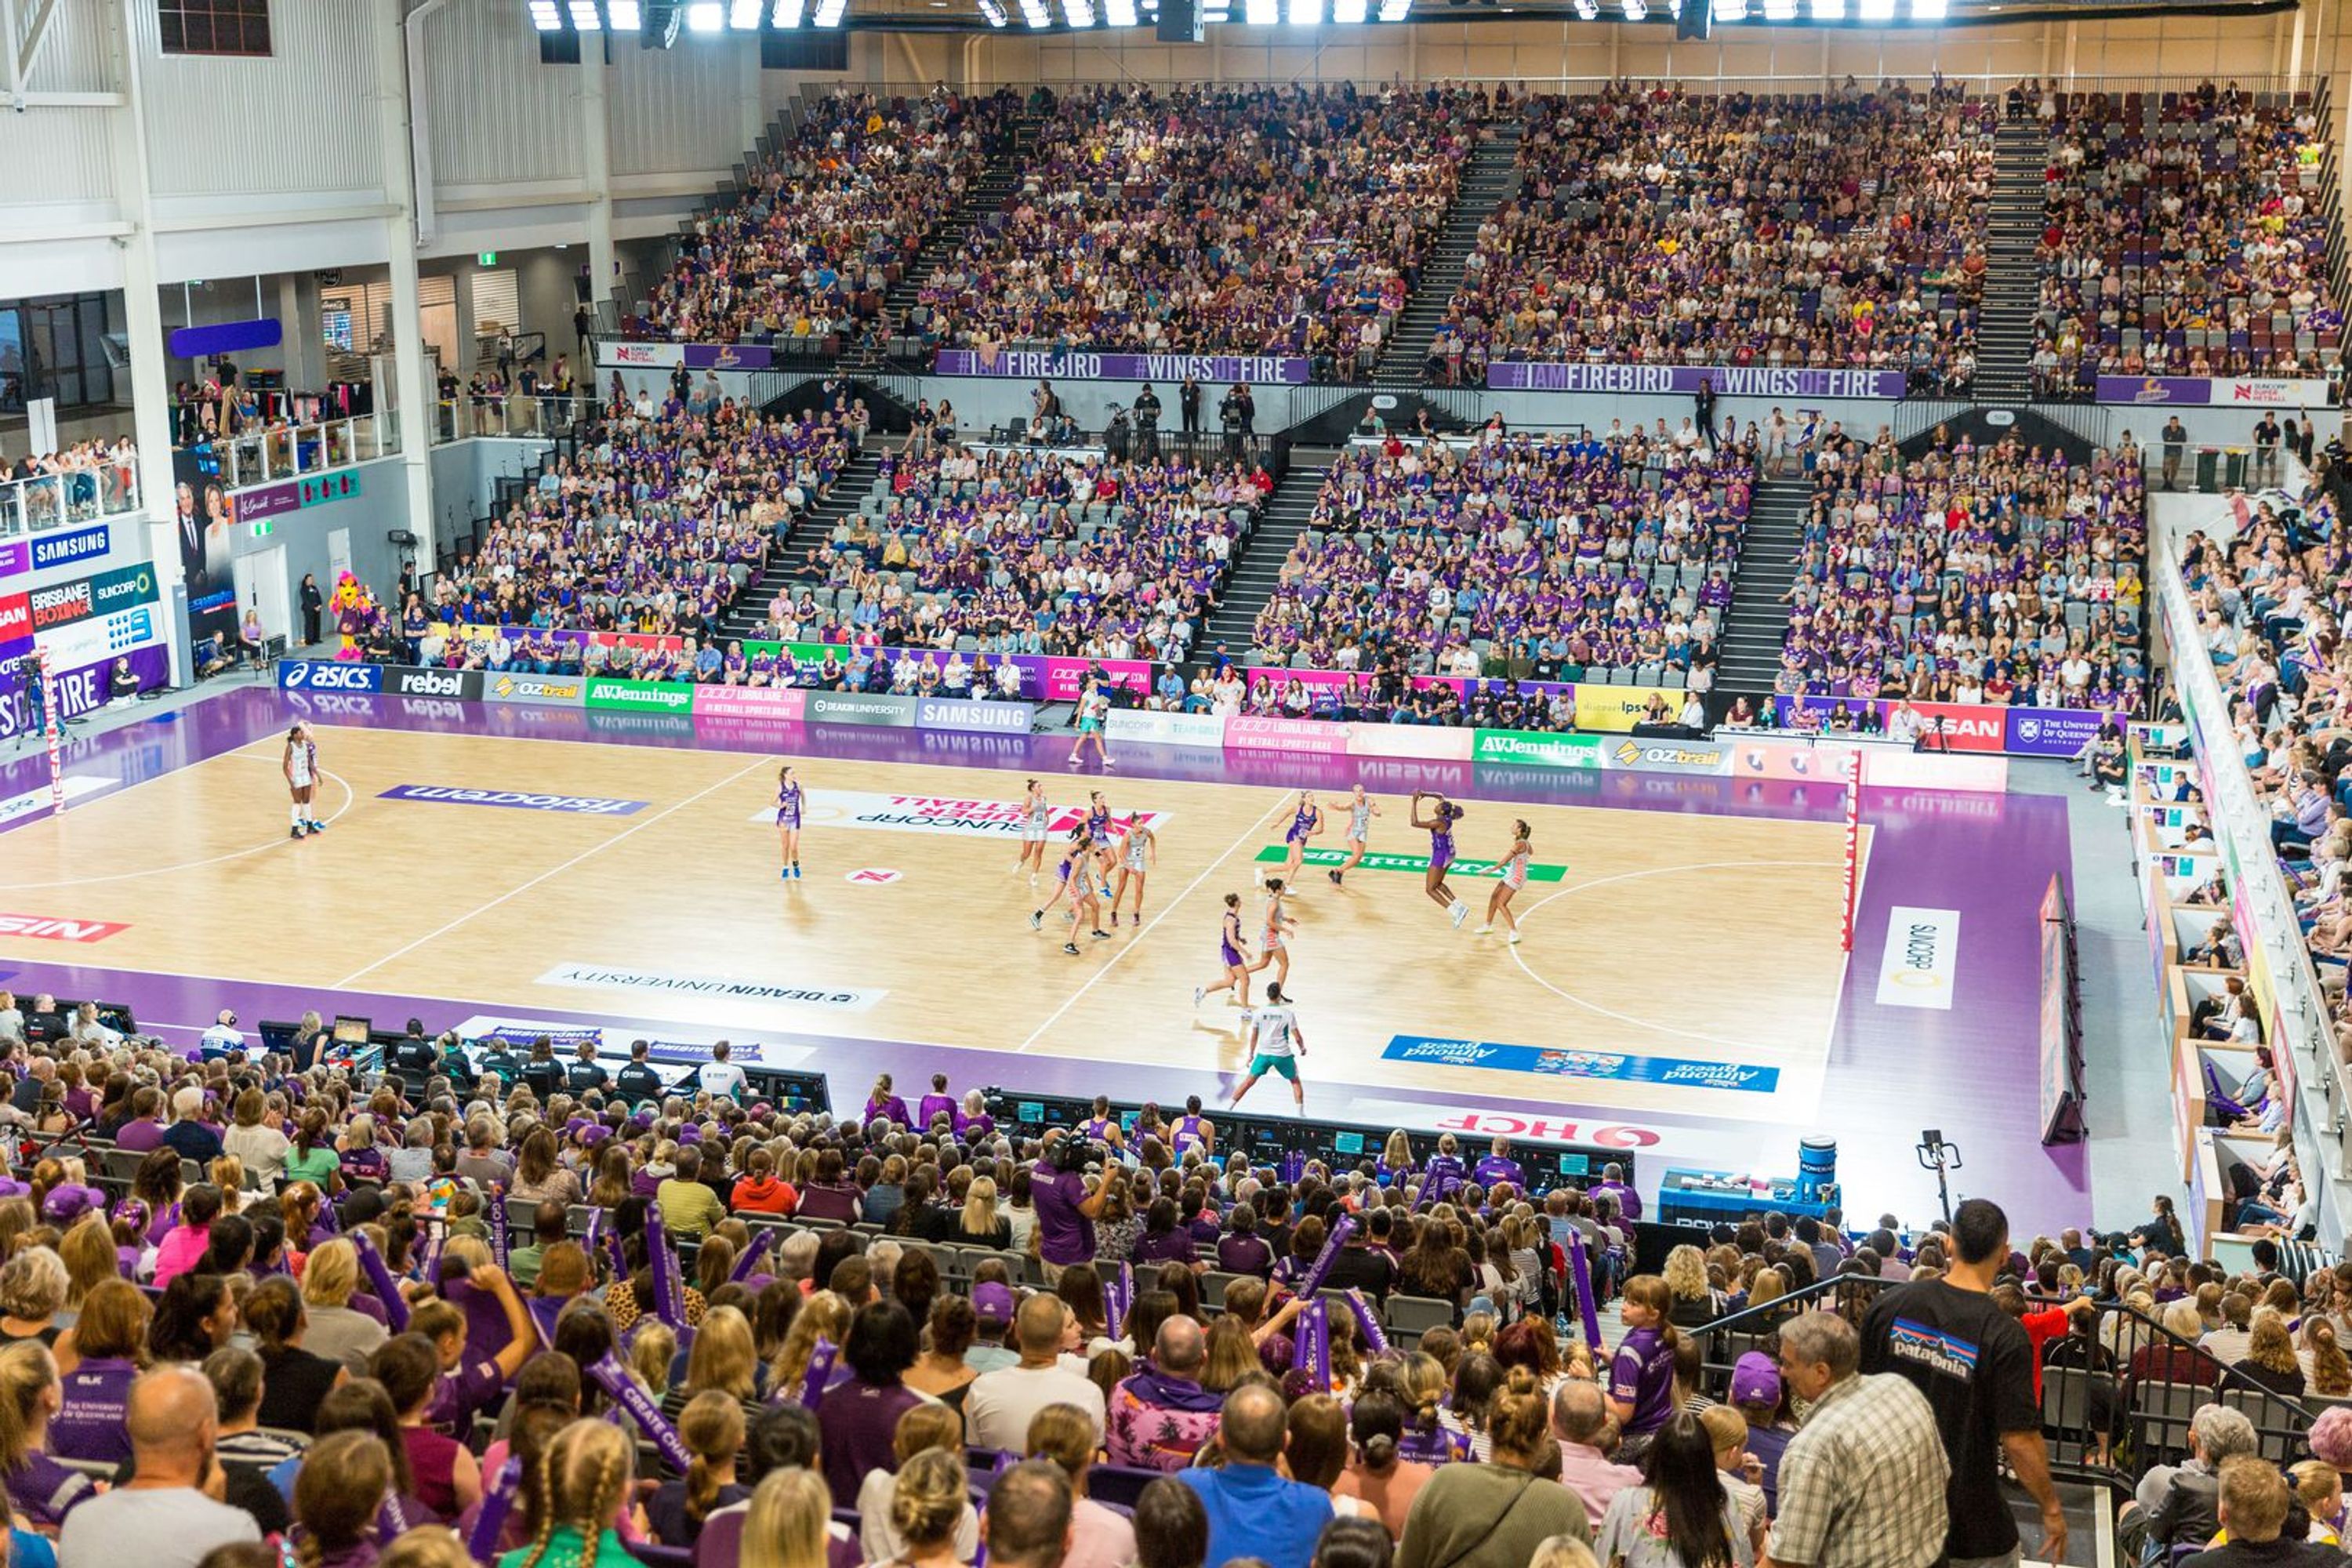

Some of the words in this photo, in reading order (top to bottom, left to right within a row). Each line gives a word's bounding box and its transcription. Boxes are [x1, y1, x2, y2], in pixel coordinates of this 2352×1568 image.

[1135, 356, 1287, 381] #WINGSOFFIRE
[1511, 364, 1673, 391] #IAMFIREBIRD
[1710, 368, 1881, 396] #WINGSOFFIRE
[36, 532, 106, 563] SAMSUNG
[31, 583, 86, 612] BRISBANE
[97, 580, 136, 600] SUNCORP
[34, 600, 89, 626] BOXING
[401, 670, 464, 695] rebel
[518, 681, 579, 699] OZtrail
[590, 684, 689, 706] AVJennings
[827, 702, 855, 712] DEAKIN
[855, 703, 906, 715] UNIVERSITY
[923, 704, 1025, 727] SAMSUNG
[1479, 735, 1595, 760] AVJennings
[1646, 749, 1720, 766] OZtrail
[404, 786, 629, 813] fisiocrem
[856, 812, 1024, 831] SUNCORP
[1906, 924, 1937, 971] SUNCORP
[562, 970, 728, 994] UNIVERSITY
[728, 984, 826, 1002] DEAKIN
[1403, 1047, 1498, 1059] Almond
[1417, 1041, 1482, 1051] Breeze
[1662, 1069, 1759, 1082] Almond
[1673, 1064, 1740, 1073] Breeze
[1437, 1115, 1578, 1139] HCF
[1894, 1341, 1967, 1378] patagonia
[623, 1387, 666, 1435] CREATE
[662, 1431, 695, 1467] CHAN
